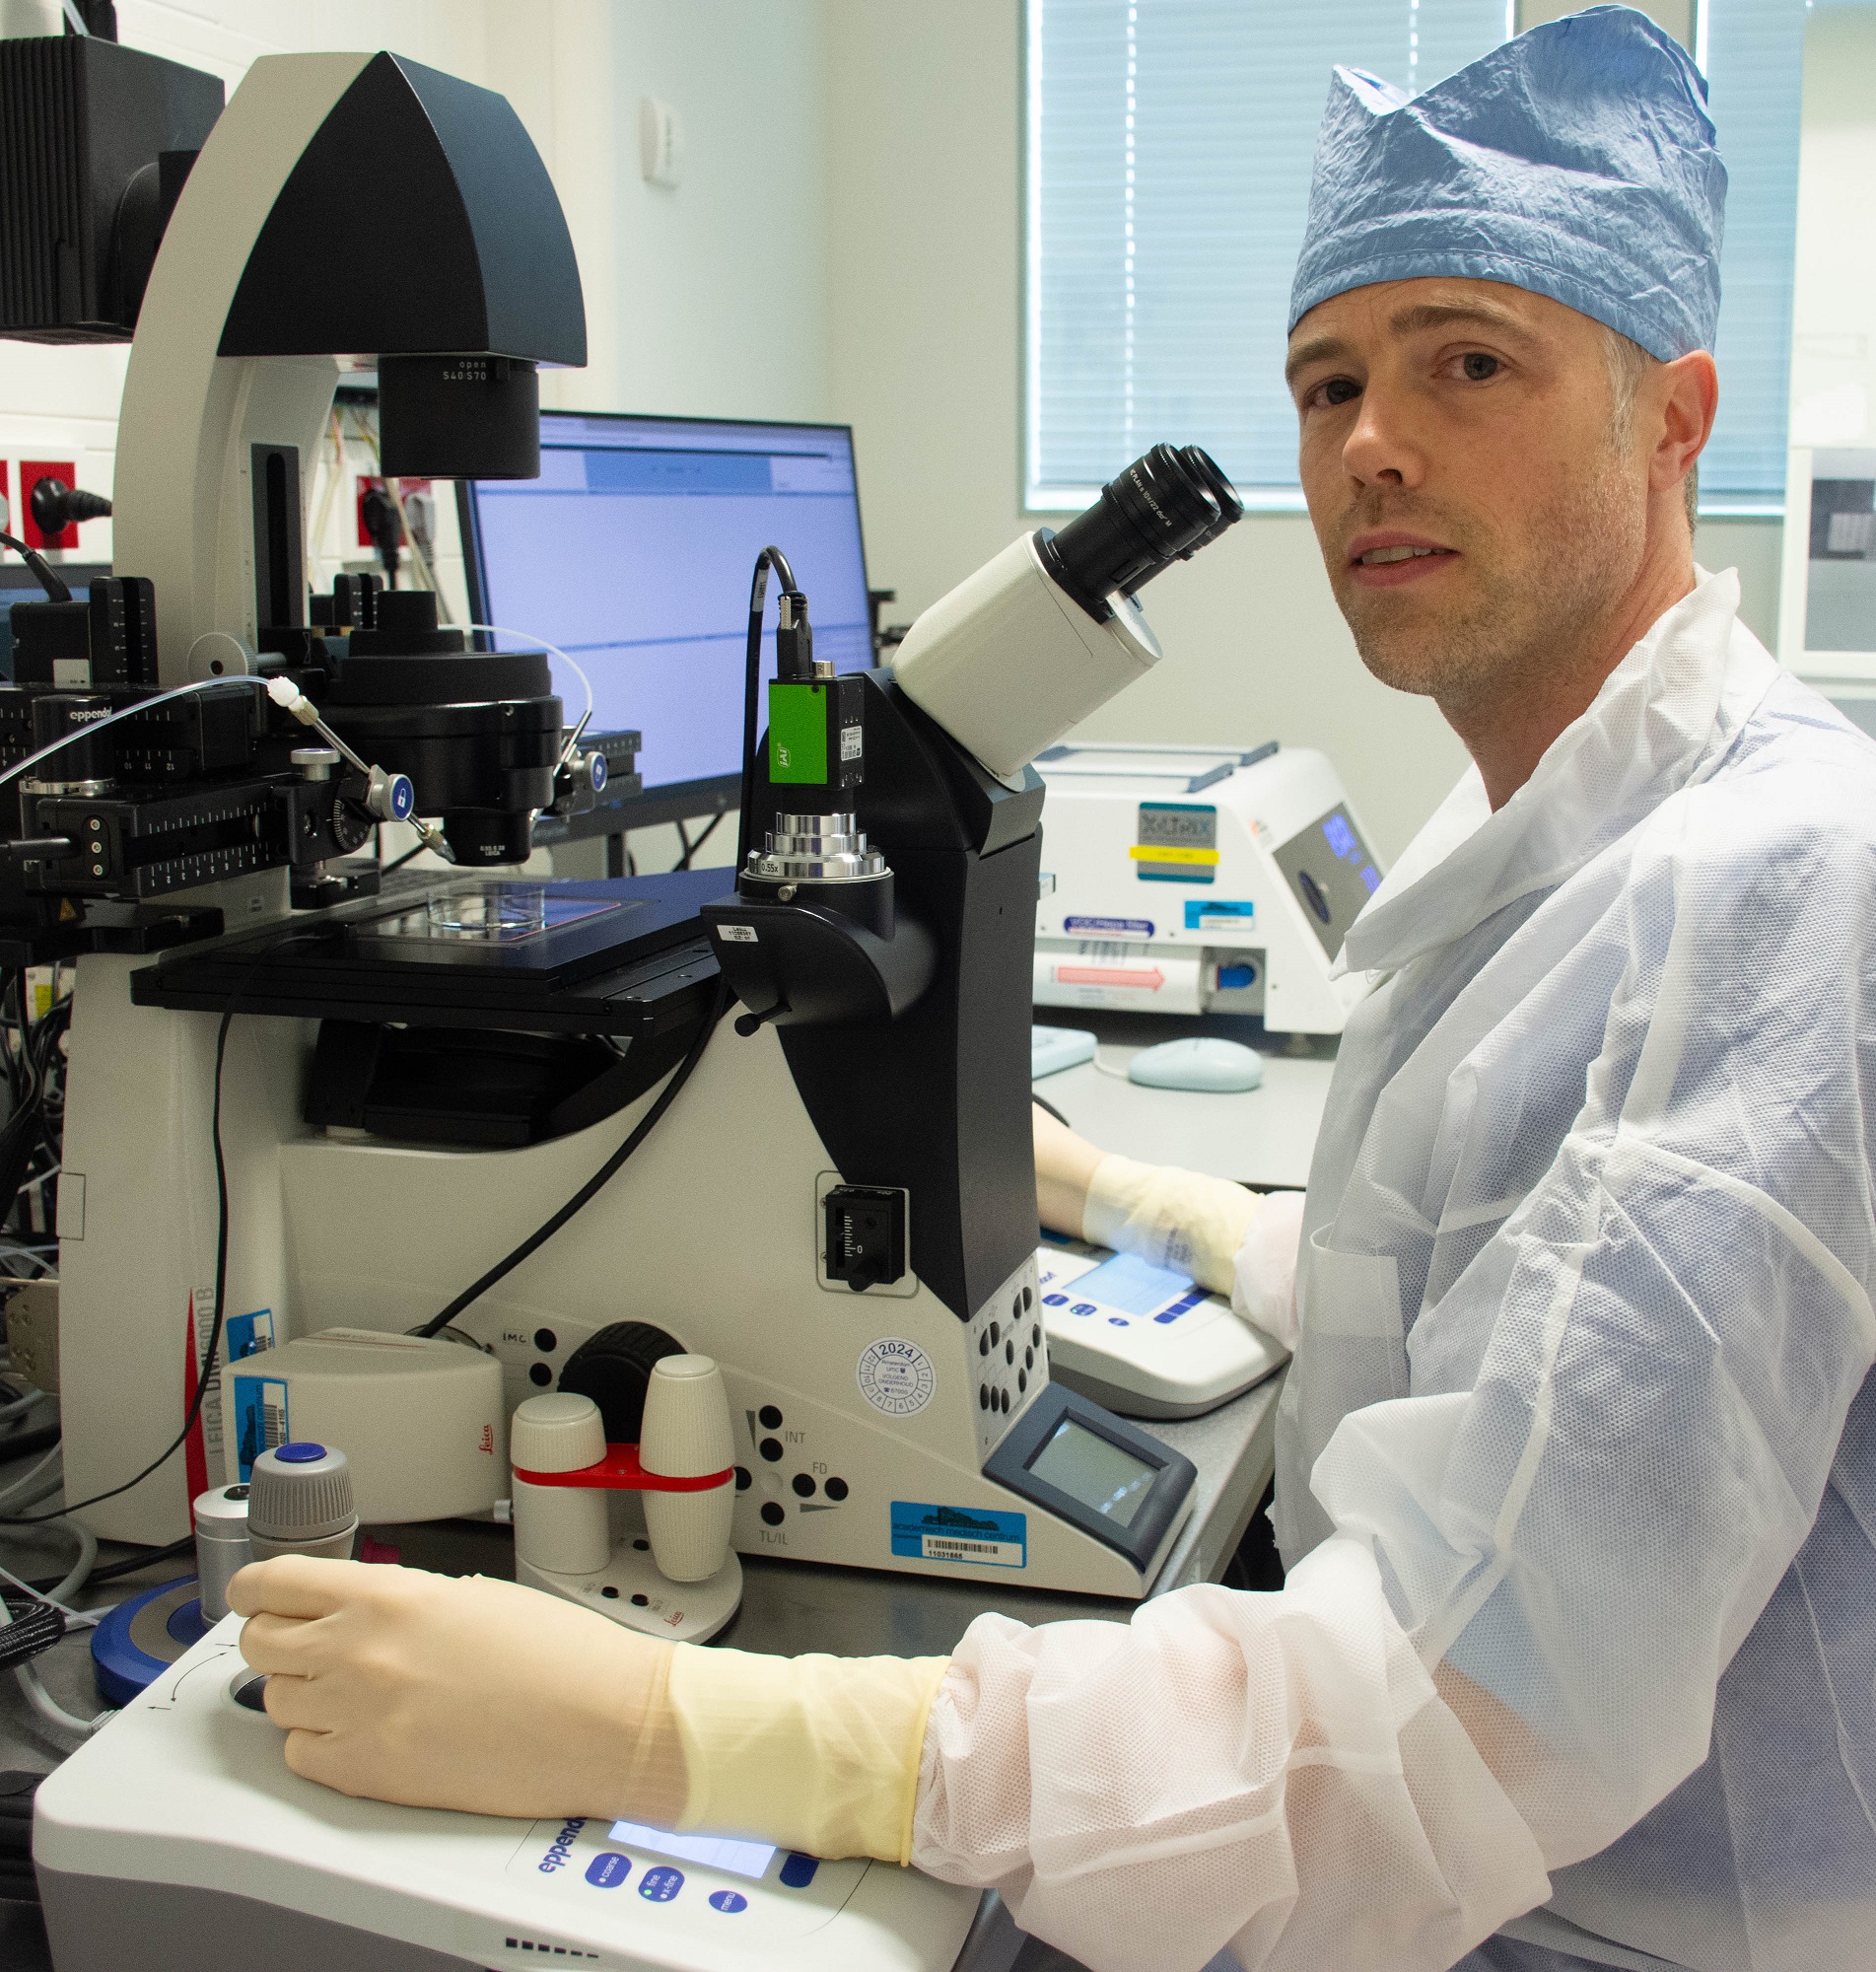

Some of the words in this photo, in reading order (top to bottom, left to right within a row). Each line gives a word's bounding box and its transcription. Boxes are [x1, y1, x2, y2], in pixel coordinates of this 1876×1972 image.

[459, 361, 487, 370] open
[443, 371, 463, 381] S40
[466, 371, 487, 381] S70
[761, 863, 779, 874] 0.55x
[857, 1245, 863, 1254] 0
[504, 1332, 526, 1343] IMC
[878, 1342, 914, 1359] 2024
[478, 1424, 494, 1455] Leica
[785, 1431, 806, 1444] INT
[812, 1461, 828, 1475] FD
[759, 1529, 790, 1545] TL/IL
[892, 1522, 944, 1535] academisch
[946, 1526, 983, 1538] medisch
[985, 1530, 1020, 1542] centrum
[538, 1817, 588, 1873] eppend
[602, 1856, 620, 1878] coarse
[647, 1874, 660, 1888] fine
[663, 1874, 678, 1895] x-fine
[721, 1892, 736, 1911] menu
